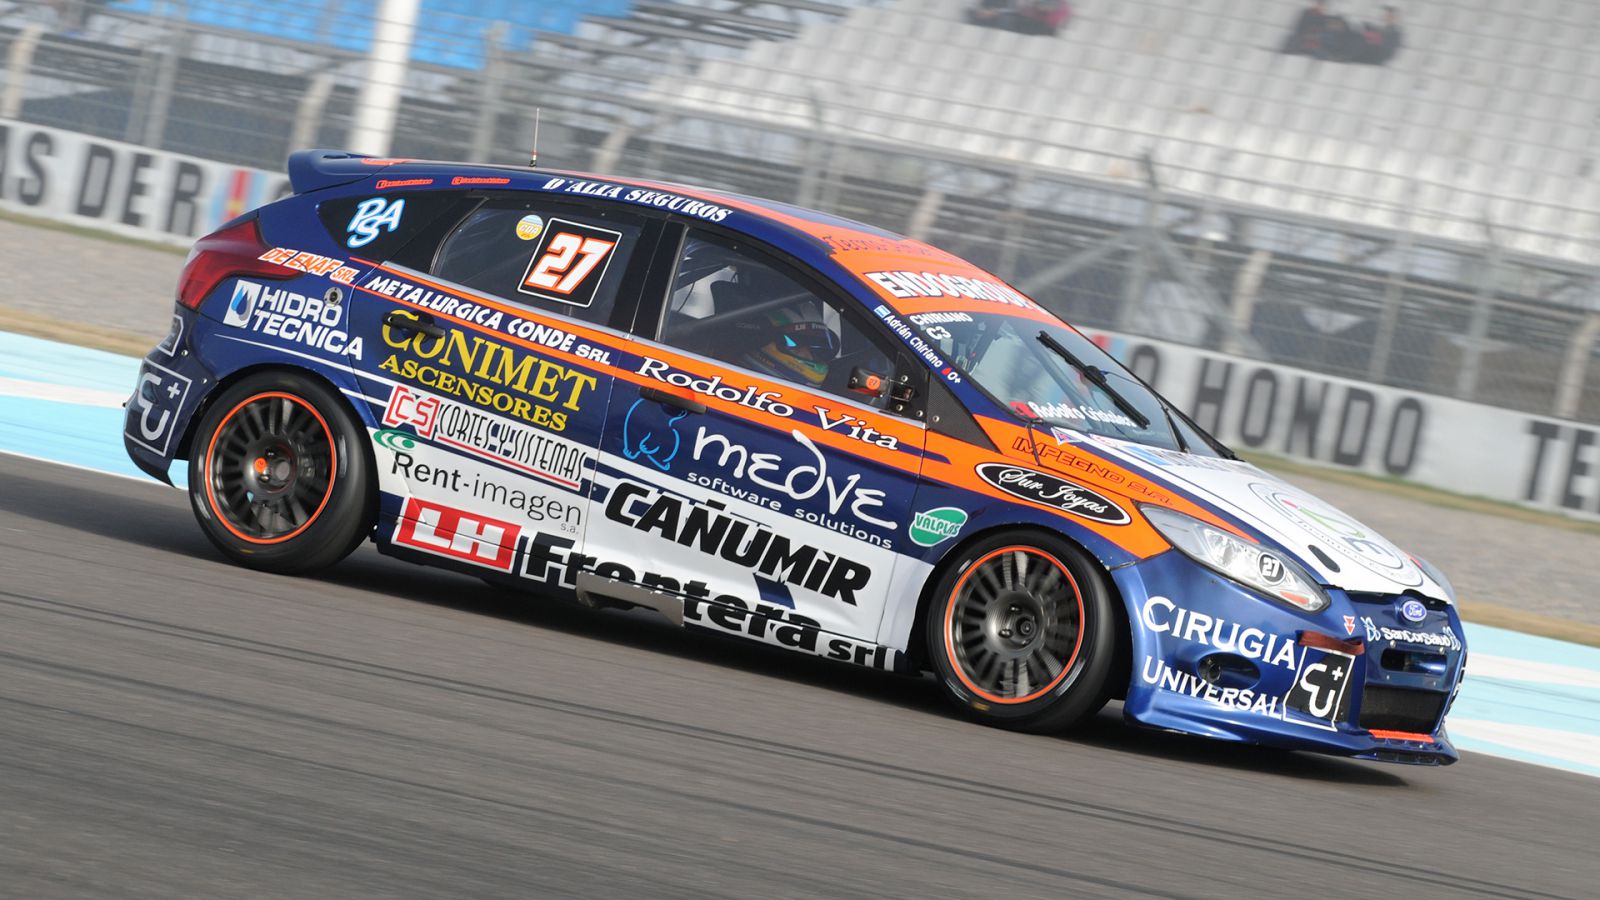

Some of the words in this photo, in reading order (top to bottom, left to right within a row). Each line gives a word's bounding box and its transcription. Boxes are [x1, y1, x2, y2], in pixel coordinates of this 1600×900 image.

[624, 189, 734, 223] SEGUROS
[259, 247, 292, 265] DE
[332, 266, 361, 286] SRL
[523, 231, 617, 296] 27
[257, 286, 344, 328] HIDRO
[364, 275, 504, 332] METALURGICA
[507, 318, 577, 352] CONDE
[574, 343, 612, 367] SRL
[250, 309, 363, 361] TECNICA
[381, 308, 598, 412] CONIMET
[883, 314, 913, 340] Adrián
[909, 337, 944, 369] Chiriano
[378, 353, 569, 433] ASCENSORES
[635, 356, 795, 418] Rodolfo
[813, 405, 899, 451] Vita
[1189, 354, 1426, 477] HONDO
[1010, 436, 1127, 485] IMPEGNO
[391, 450, 582, 527] Rent-imagen
[686, 470, 783, 512] software
[794, 505, 893, 550] solutions
[997, 467, 1045, 491] Sur
[1038, 484, 1109, 515] Joyas
[411, 507, 507, 561] LH
[560, 522, 580, 535] s.a.
[914, 511, 962, 538] VALPLAS
[1261, 556, 1281, 578] 27
[1141, 596, 1297, 671] CIRUGIA
[1141, 655, 1283, 721] UNIVERSAL
